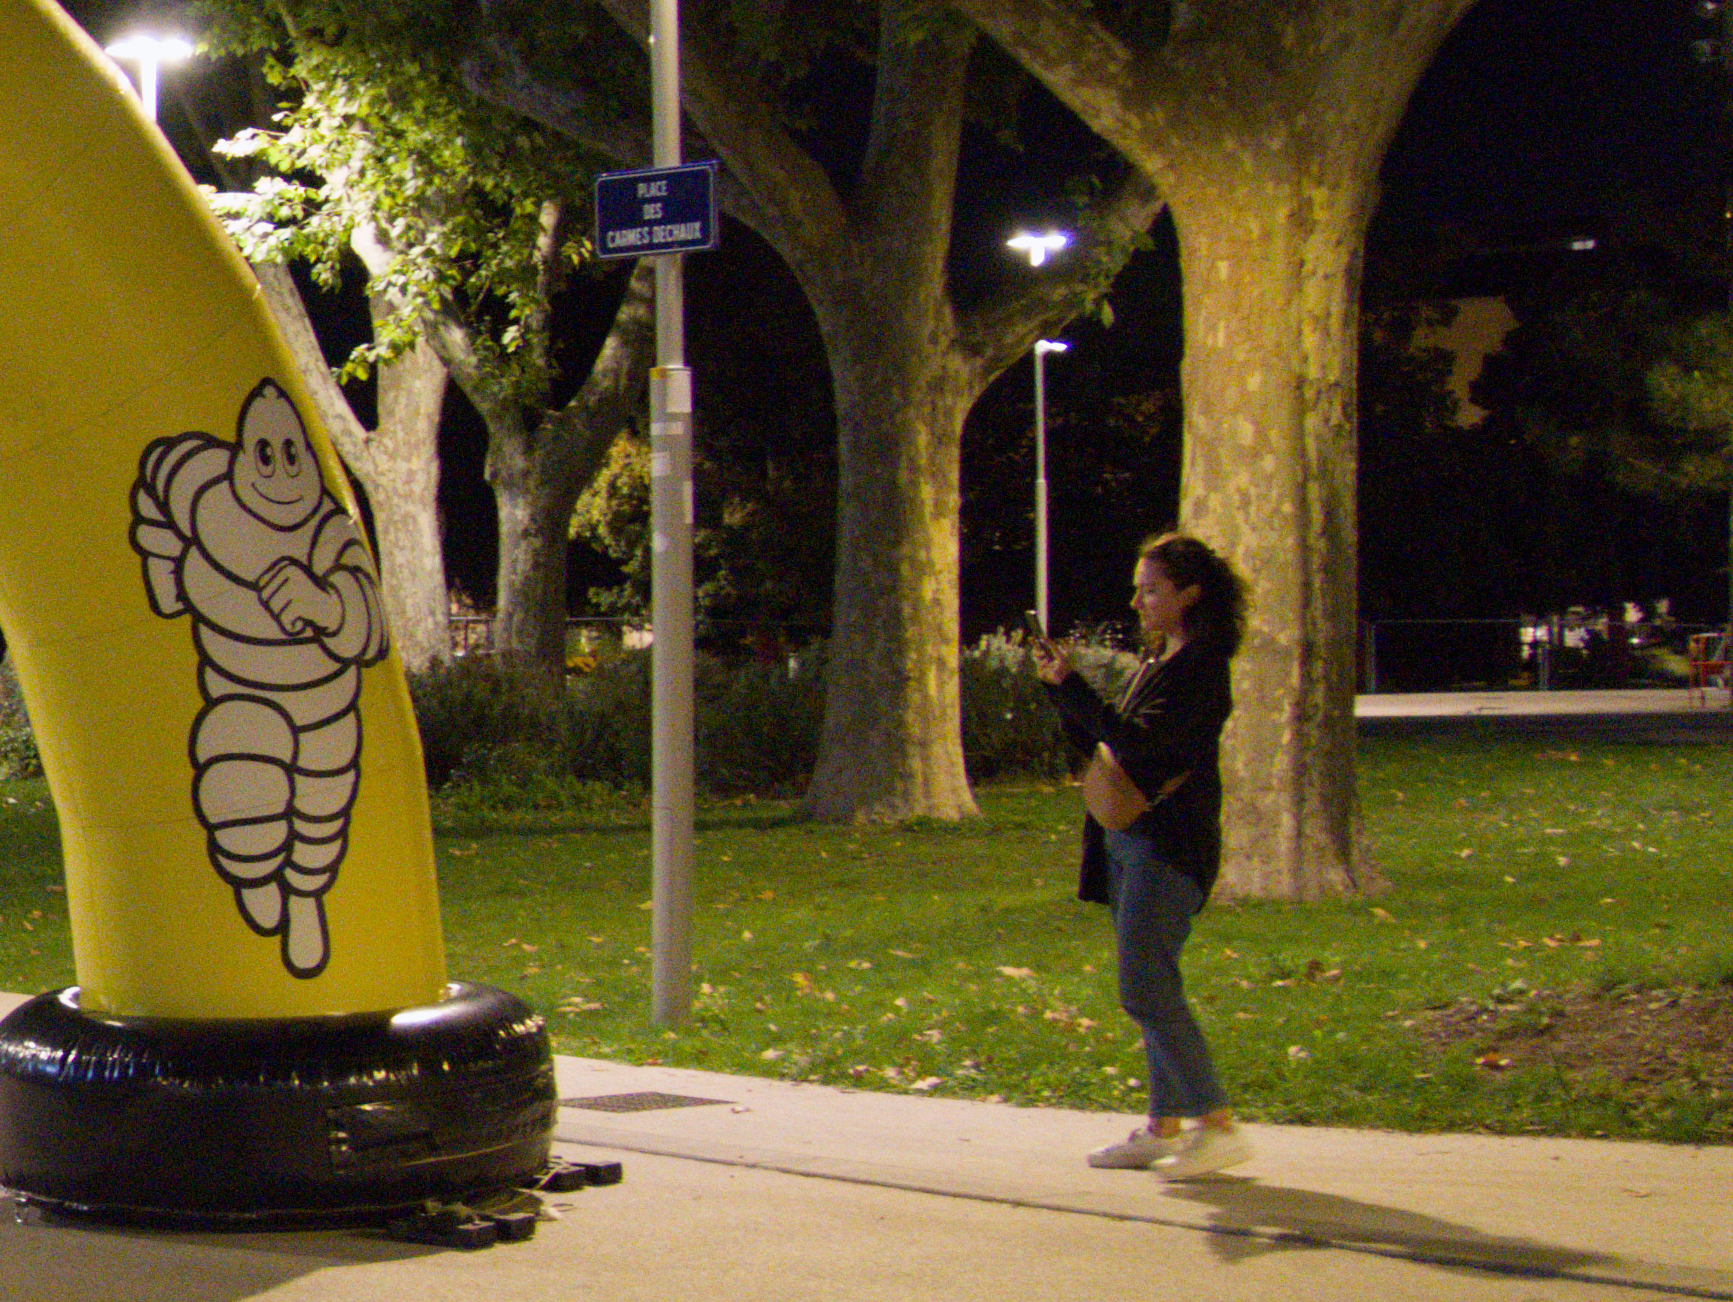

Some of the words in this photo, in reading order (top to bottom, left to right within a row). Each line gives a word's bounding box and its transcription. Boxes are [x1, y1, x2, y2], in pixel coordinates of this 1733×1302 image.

[637, 180, 668, 198] PLACE
[643, 202, 663, 220] DES
[607, 226, 650, 248] CARMES
